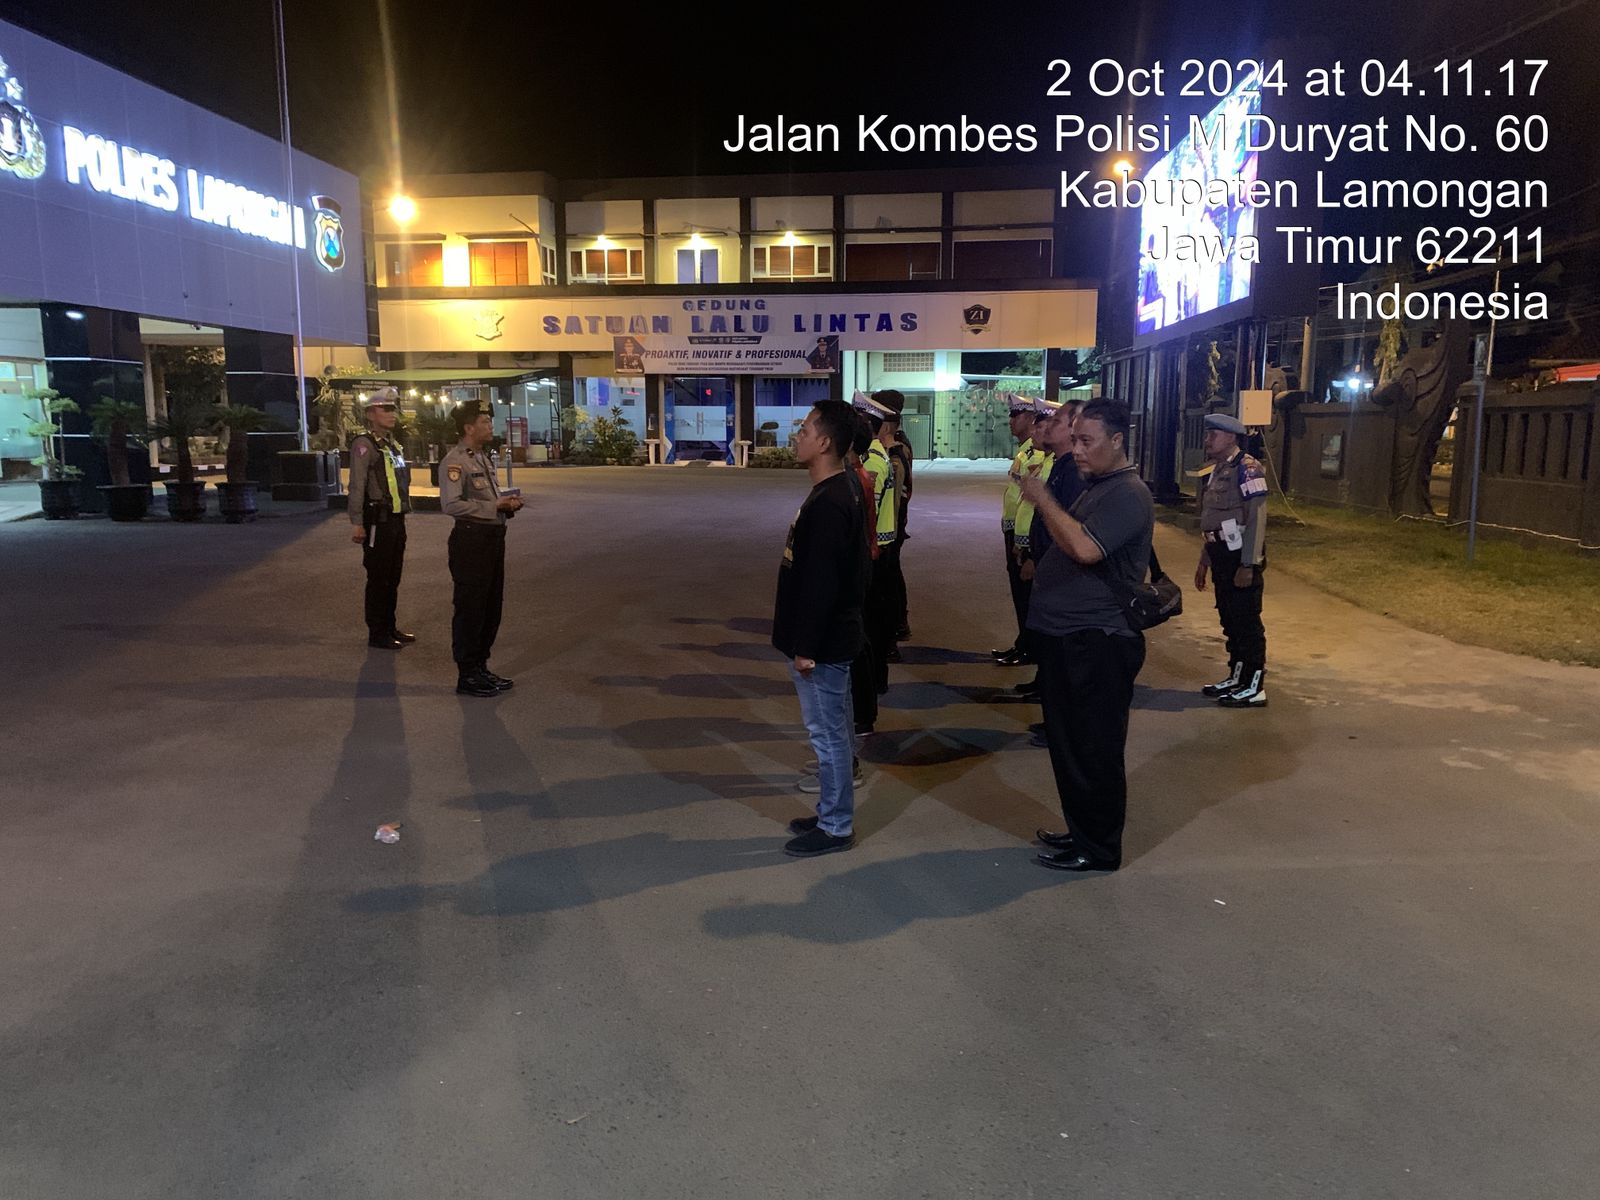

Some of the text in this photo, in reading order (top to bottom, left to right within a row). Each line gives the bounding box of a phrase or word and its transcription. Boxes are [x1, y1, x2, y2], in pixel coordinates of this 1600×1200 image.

[63, 125, 179, 212] POLRES
[683, 299, 766, 311] GEDUNG
[543, 312, 918, 334] SATUAN LALU LINTAS
[645, 349, 807, 359] PROAKTIF, INOVATIF & PROFESIONAL
